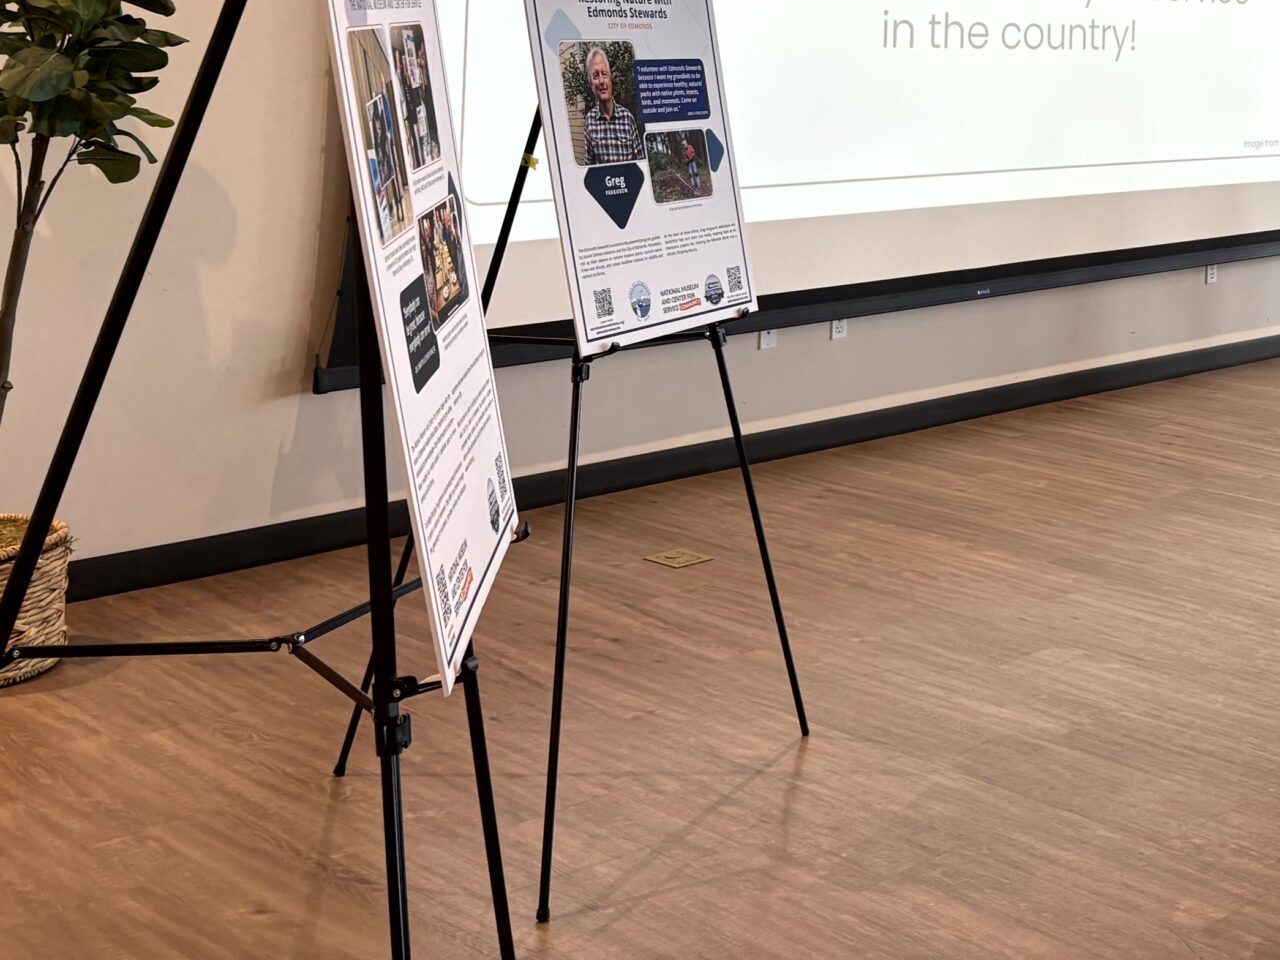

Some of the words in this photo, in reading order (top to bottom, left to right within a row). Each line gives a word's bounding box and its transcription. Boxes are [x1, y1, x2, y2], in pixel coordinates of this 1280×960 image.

[587, 6, 628, 18] Edmonds
[629, 7, 667, 19] Stewards
[883, 10, 914, 48] in
[929, 12, 988, 49] the
[1002, 19, 1135, 62] country!
[606, 175, 626, 188] Greg
[660, 286, 681, 296] NATIONAL
[681, 283, 699, 292] MUSEUM
[661, 297, 672, 305] AND
[672, 294, 690, 304] CENTER
[663, 305, 679, 314] SERVICE
